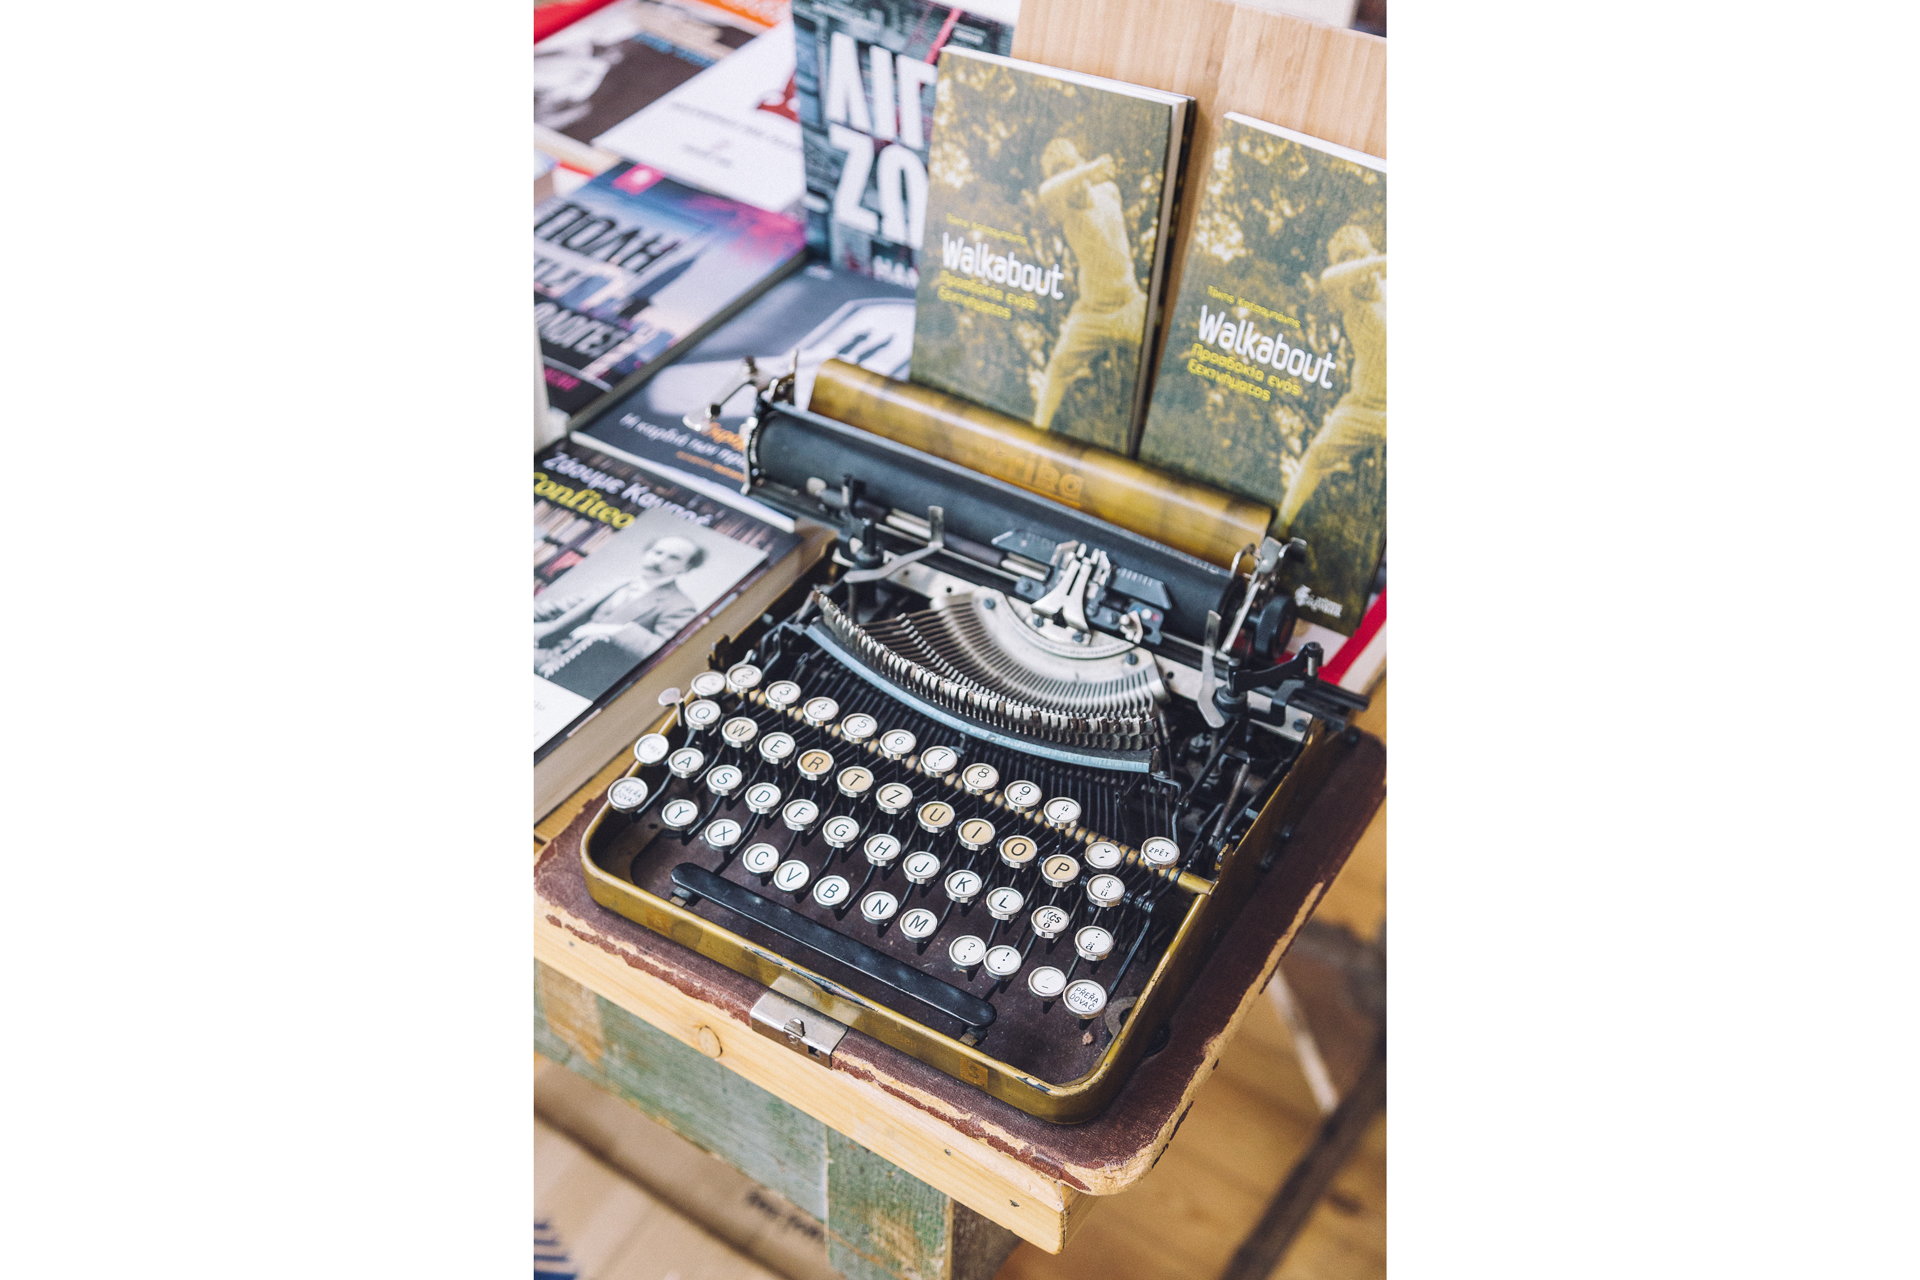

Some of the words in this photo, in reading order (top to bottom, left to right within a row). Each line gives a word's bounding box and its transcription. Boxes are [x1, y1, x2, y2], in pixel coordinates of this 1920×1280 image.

[825, 31, 938, 150] ΛΙΓ
[828, 123, 929, 250] ΖΩ
[942, 231, 1065, 300] Walkabout
[1198, 304, 1337, 389] Walkabout
[695, 706, 711, 720] Q
[732, 723, 752, 738] W
[769, 739, 787, 754] E
[677, 756, 692, 769] A
[807, 756, 824, 771] R
[716, 771, 733, 786] S
[850, 773, 864, 787] T
[977, 767, 990, 779] 8
[754, 789, 771, 803] D
[886, 789, 903, 805] Z
[1019, 785, 1032, 796] 9
[674, 806, 690, 820] Y
[793, 806, 809, 819] F
[929, 807, 946, 822] U
[713, 825, 734, 842] X
[833, 823, 850, 838] G
[873, 841, 891, 856] H
[1011, 842, 1027, 857] O
[754, 851, 770, 866] C
[914, 860, 930, 874] J
[1053, 862, 1070, 876] P
[786, 866, 803, 884] V
[822, 883, 840, 899] B
[955, 877, 973, 893] K
[870, 898, 890, 915] N
[908, 914, 929, 933] M
